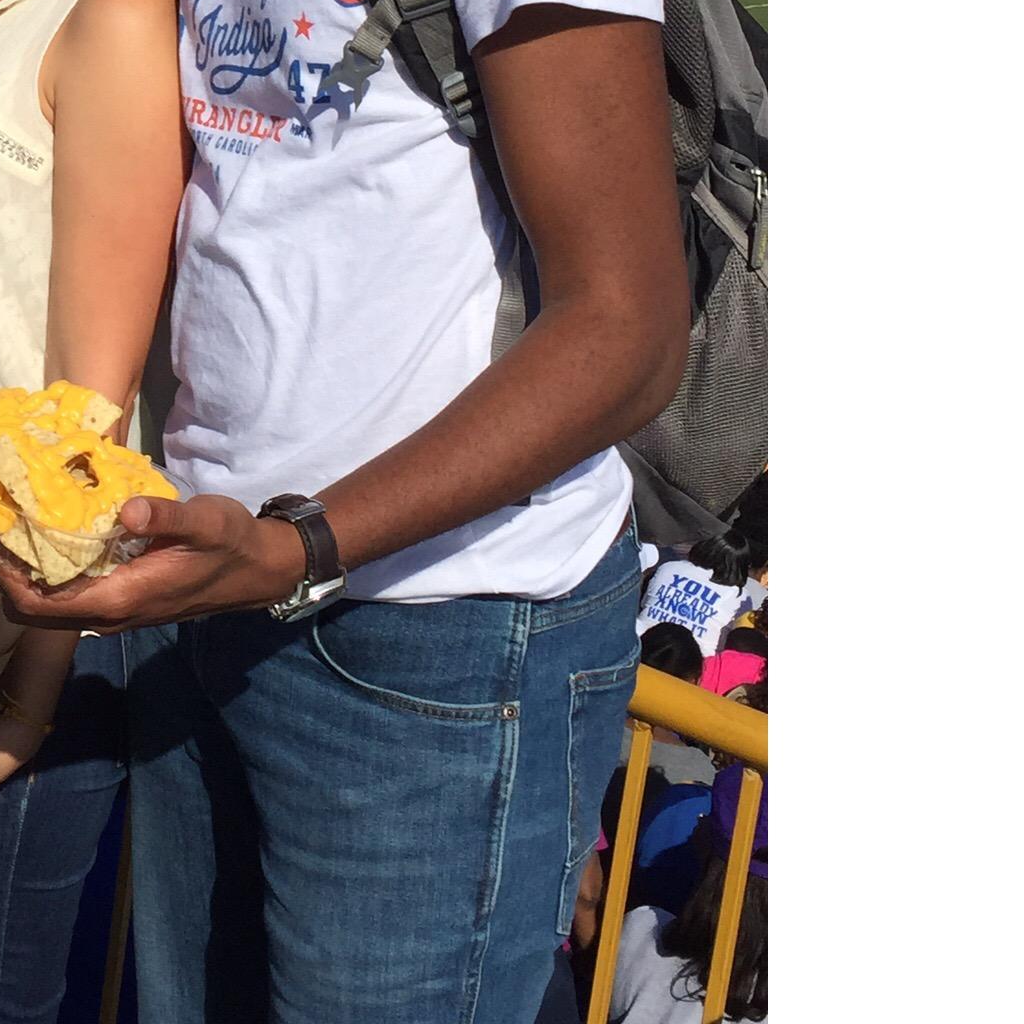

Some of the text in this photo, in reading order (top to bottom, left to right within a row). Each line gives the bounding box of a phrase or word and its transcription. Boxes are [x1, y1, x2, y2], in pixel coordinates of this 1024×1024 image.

[196, 5, 283, 89] Indigo
[656, 584, 718, 618] ALREADY
[670, 574, 721, 606] YOU
[691, 623, 707, 639] IT
